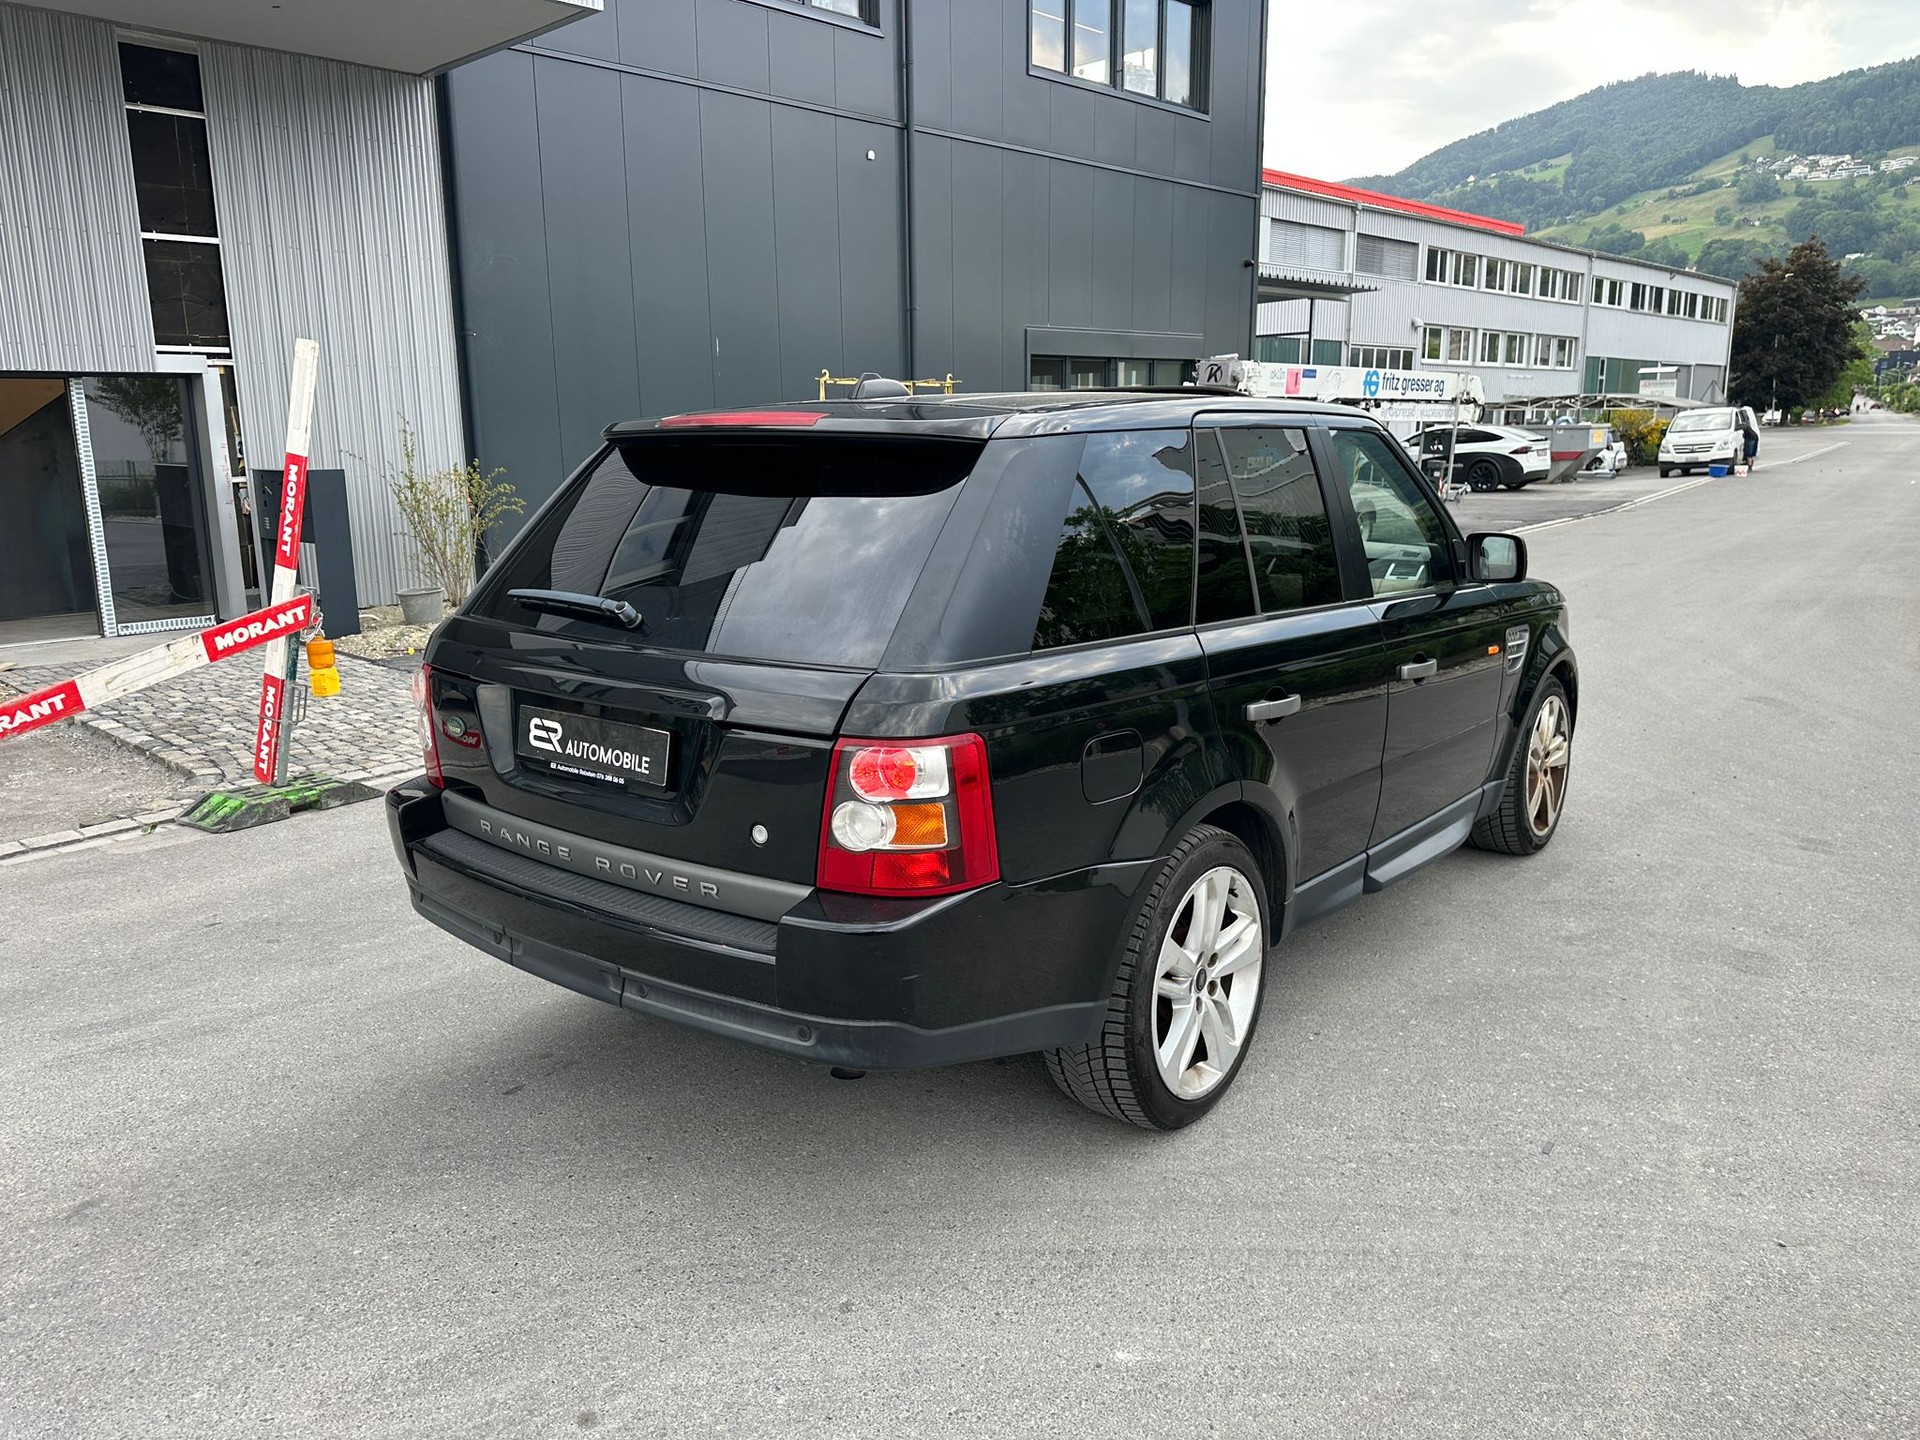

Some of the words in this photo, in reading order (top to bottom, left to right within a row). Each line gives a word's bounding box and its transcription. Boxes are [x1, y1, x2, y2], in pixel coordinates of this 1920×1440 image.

[1382, 372, 1400, 391] fritz
[1400, 376, 1434, 396] gresser
[1433, 379, 1445, 397] ag
[281, 463, 300, 557] MORANT
[214, 604, 306, 652] MORANT
[258, 684, 277, 775] MORANT
[565, 739, 651, 775] AUTOMOBILE
[479, 818, 573, 863] RANGE
[595, 856, 721, 900] ROVER
